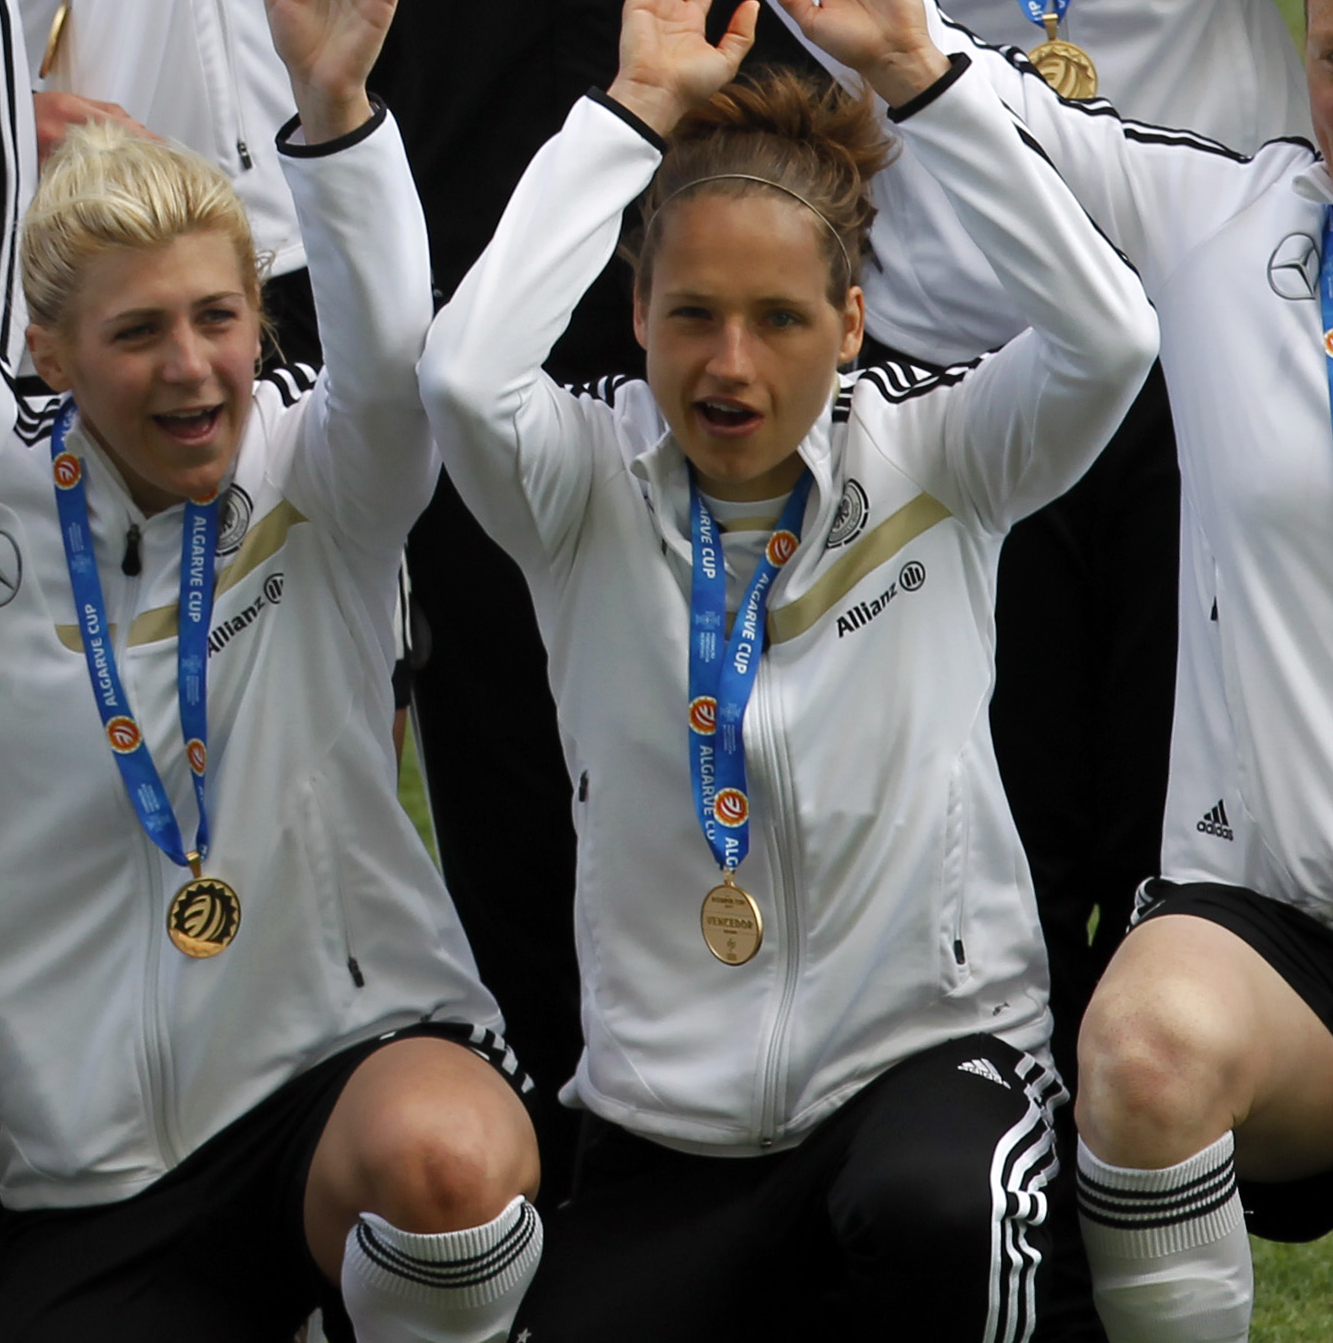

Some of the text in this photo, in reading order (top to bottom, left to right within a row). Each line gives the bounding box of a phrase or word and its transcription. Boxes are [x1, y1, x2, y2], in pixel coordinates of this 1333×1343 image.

[188, 515, 207, 623] ALGARVE CUP
[702, 546, 716, 579] CUP
[735, 572, 769, 675] ALGARVE CUP
[836, 583, 898, 638] Allianz
[85, 604, 118, 707] ALGARVE CUP
[1197, 819, 1234, 842] adidas
